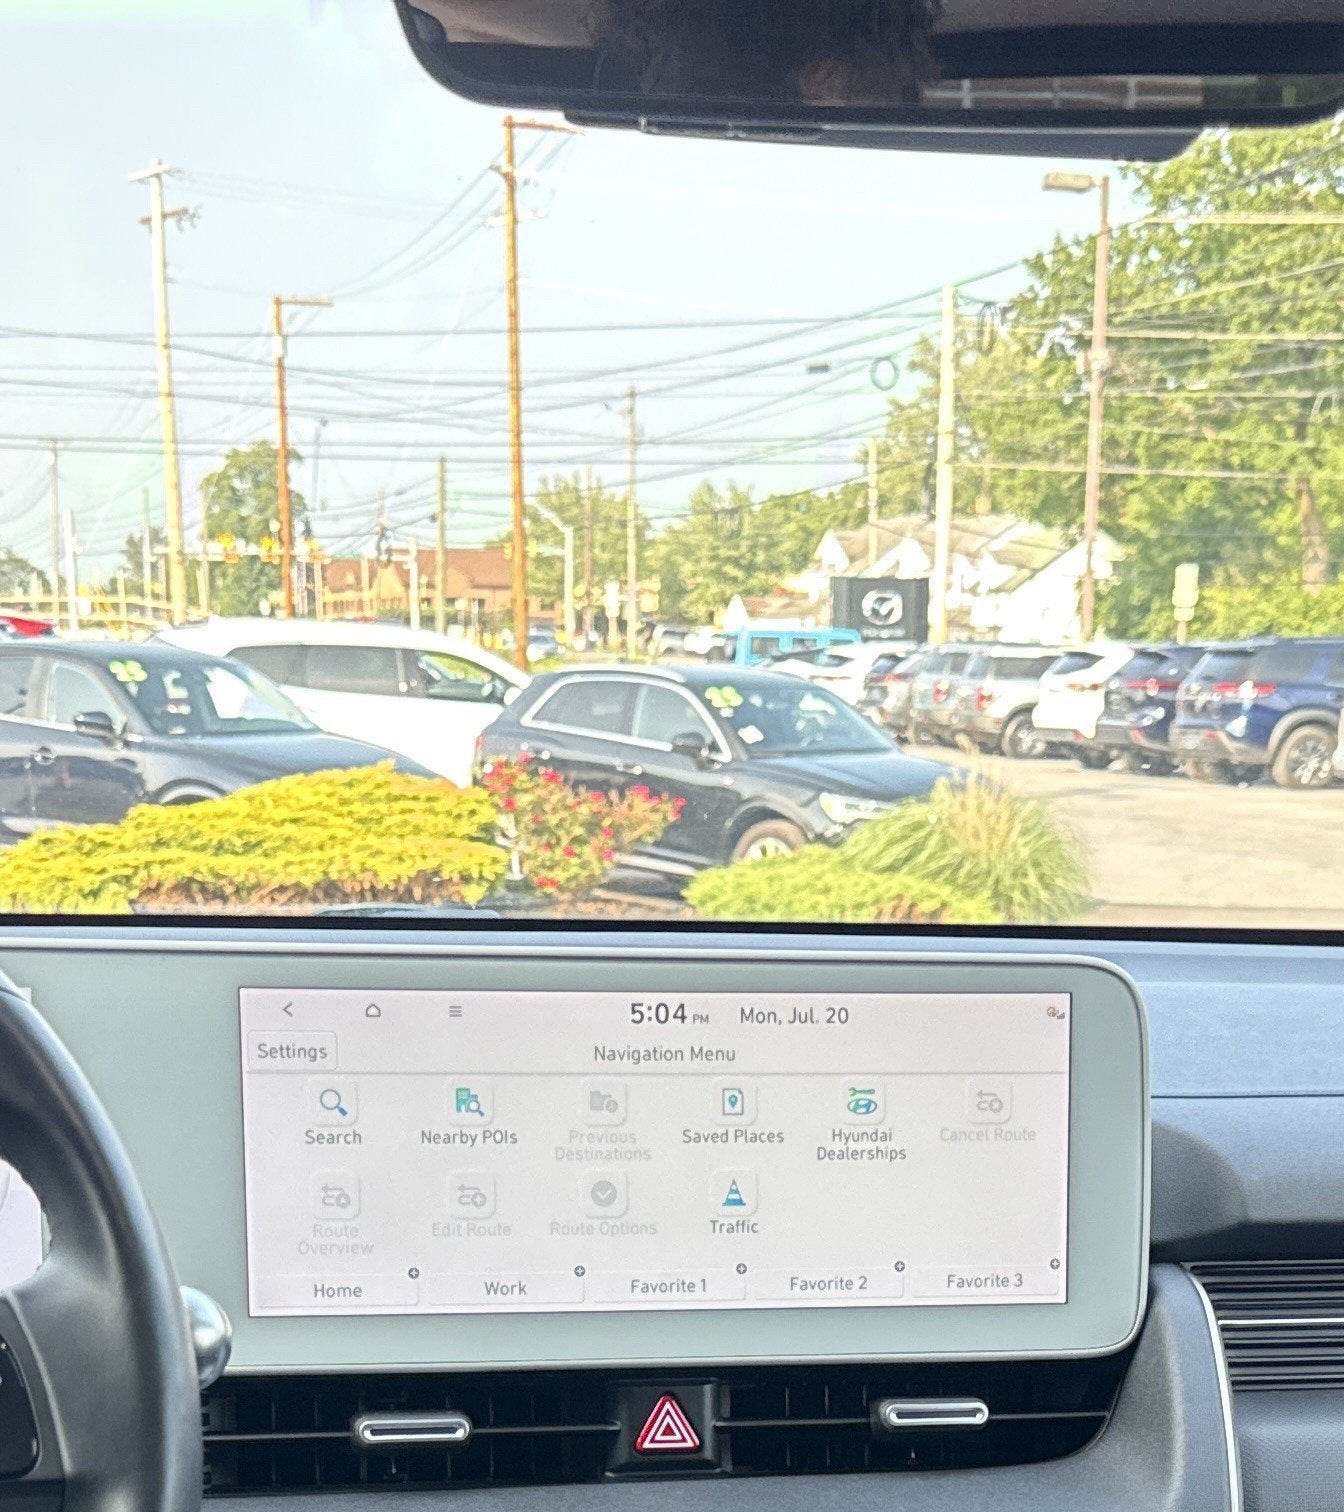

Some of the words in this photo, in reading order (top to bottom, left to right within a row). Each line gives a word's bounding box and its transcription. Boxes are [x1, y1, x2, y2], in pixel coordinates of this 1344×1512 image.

[630, 1003, 687, 1025] 5:04
[692, 1013, 711, 1024] PM
[740, 1008, 783, 1026] Mon,
[787, 1008, 820, 1024] Jul.
[825, 1008, 849, 1024] 20
[257, 1043, 328, 1063] Settings
[594, 1046, 684, 1064] Navigation
[690, 1047, 736, 1062] Menu
[304, 1129, 362, 1145] Search
[421, 1130, 477, 1147] Nearby
[482, 1130, 518, 1145] POIs
[568, 1130, 637, 1144] Previous
[682, 1129, 729, 1144] Saved
[734, 1129, 785, 1144] Places
[832, 1128, 893, 1145] Hyundai
[940, 1128, 988, 1142] Cancel
[994, 1128, 1036, 1142] Route
[554, 1146, 652, 1162] Destinations
[817, 1146, 906, 1163] Dealerships
[312, 1224, 358, 1238] Route
[432, 1223, 462, 1237] Edit
[467, 1223, 511, 1237] Route
[550, 1222, 595, 1236] Route
[599, 1222, 657, 1239] Options
[710, 1220, 759, 1234] Traffic
[297, 1240, 374, 1255] Overview
[484, 1281, 527, 1295] Work
[631, 1278, 696, 1293] Favorite
[699, 1278, 707, 1293] 1
[790, 1276, 854, 1291] Favorite
[858, 1276, 868, 1290] 2
[947, 1273, 1009, 1288] Favorite
[1014, 1273, 1023, 1288] 3
[313, 1283, 362, 1298] Home
